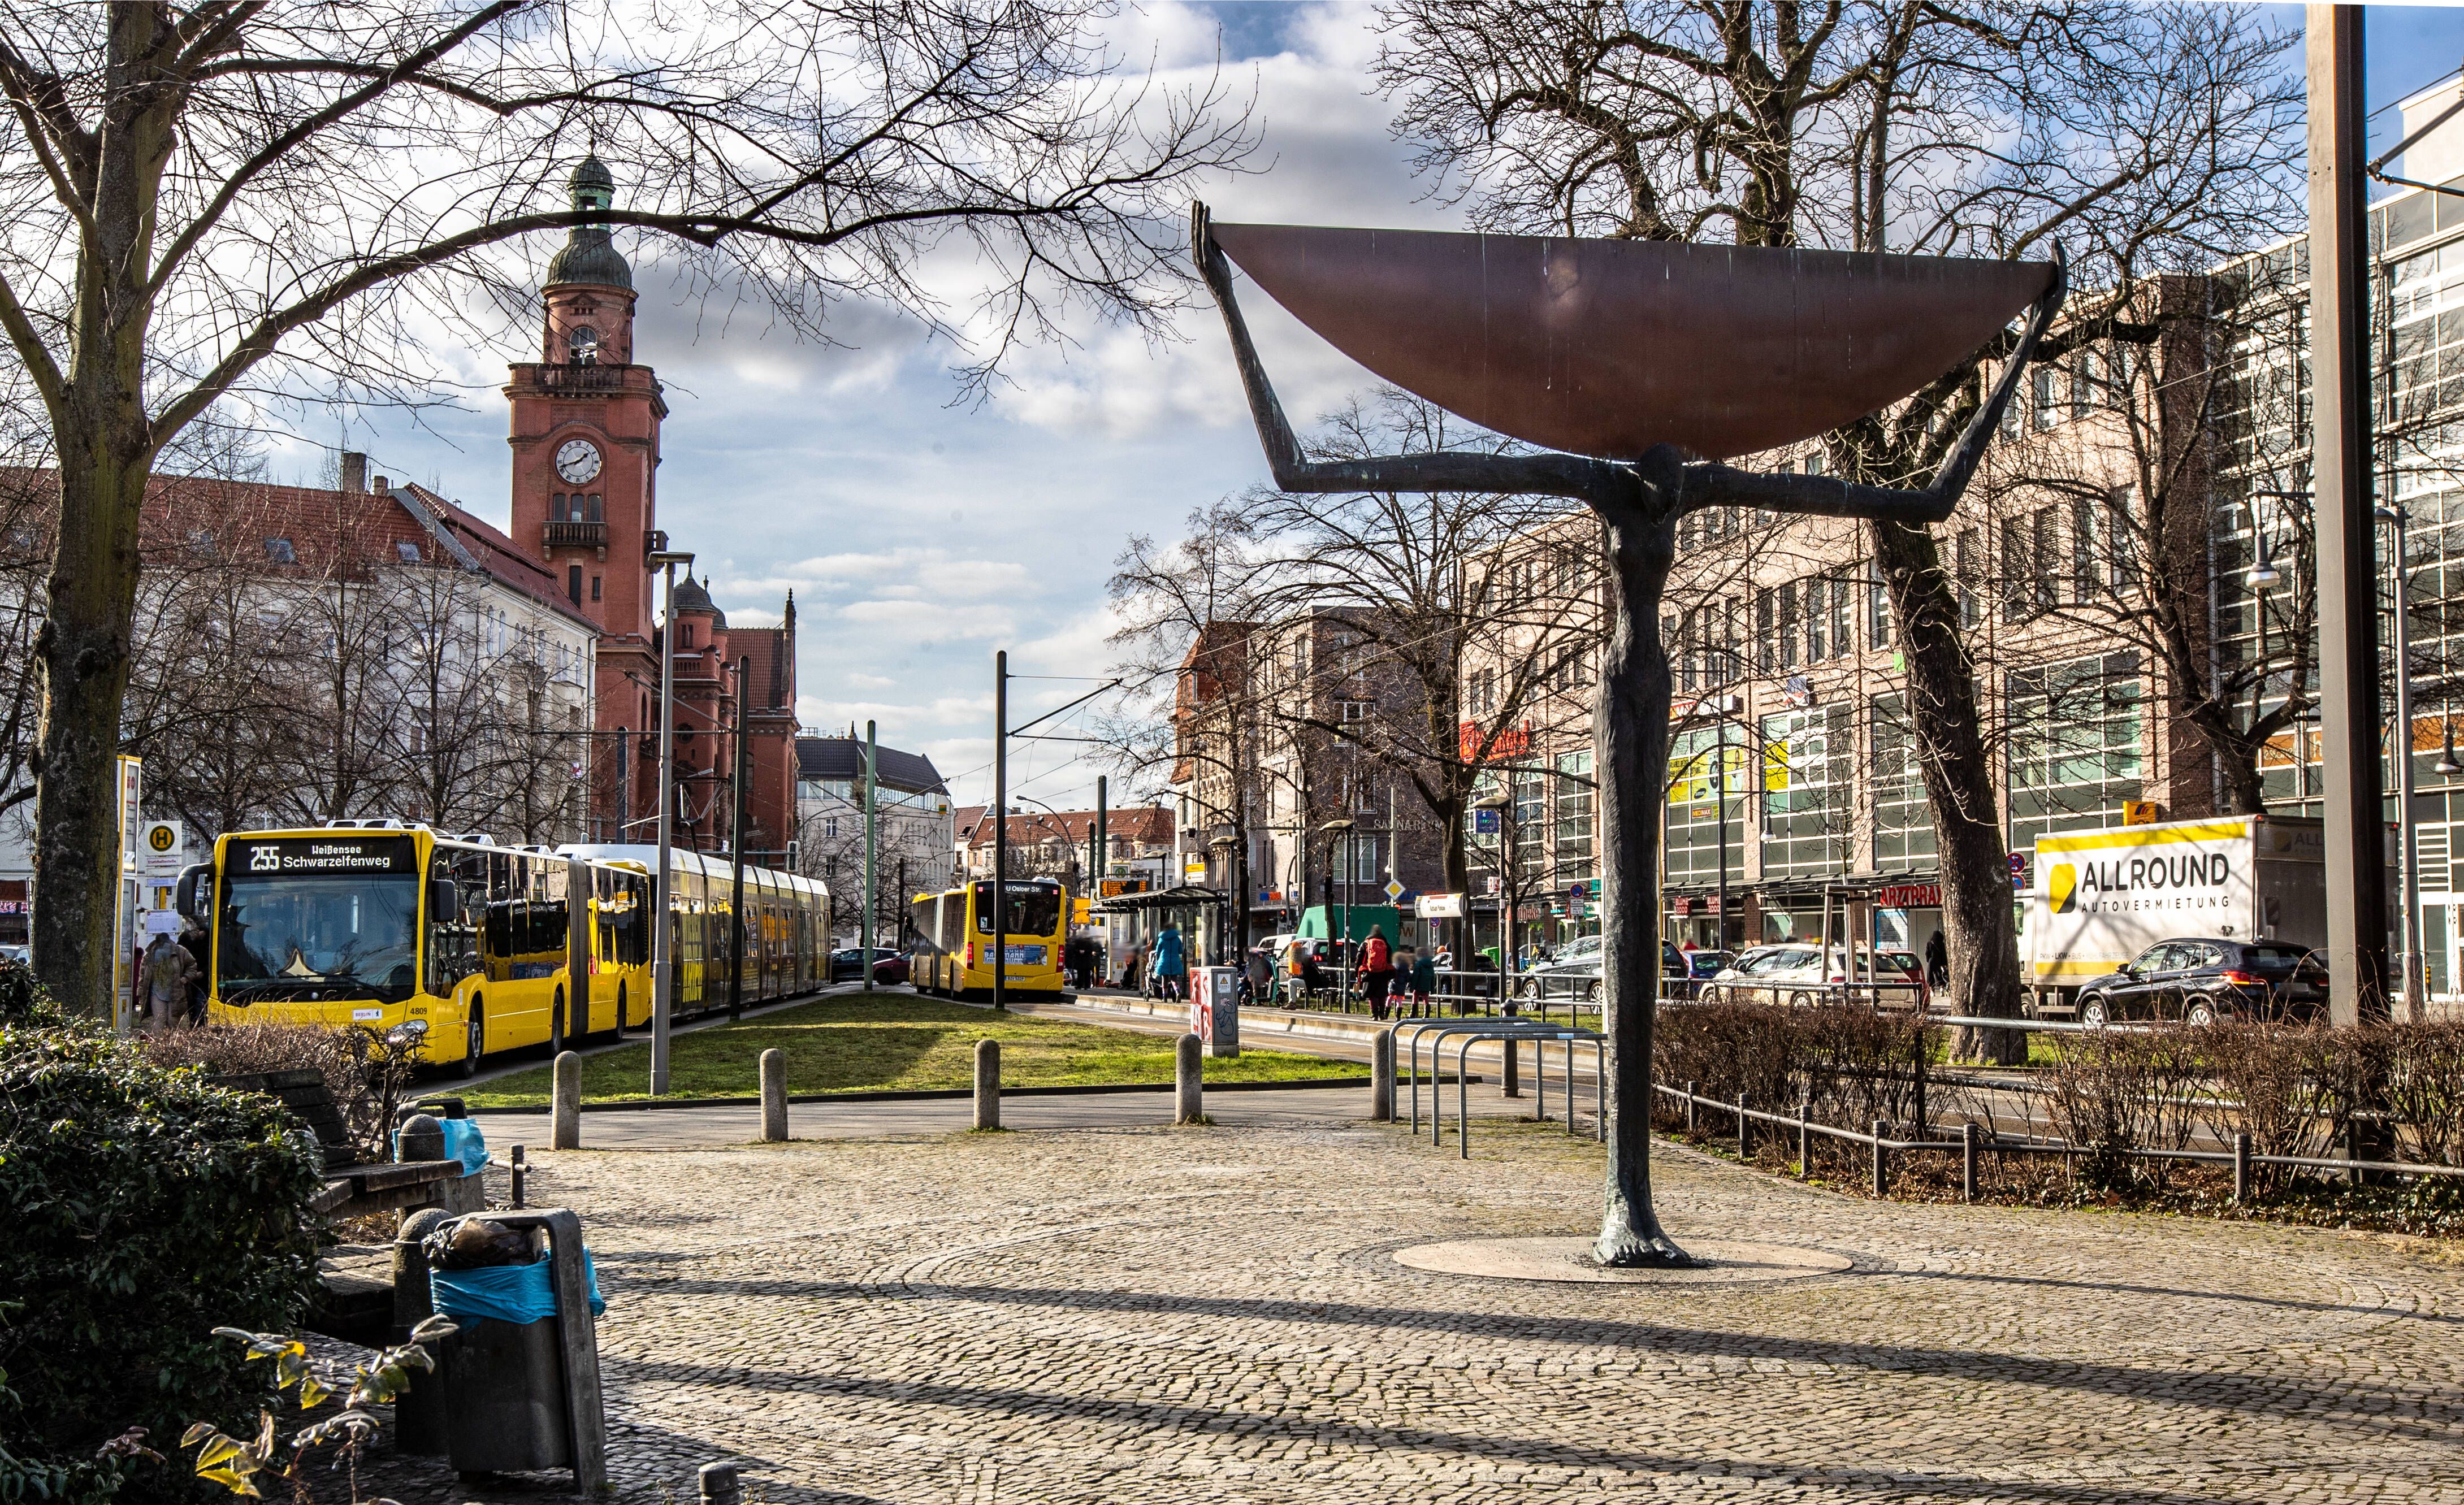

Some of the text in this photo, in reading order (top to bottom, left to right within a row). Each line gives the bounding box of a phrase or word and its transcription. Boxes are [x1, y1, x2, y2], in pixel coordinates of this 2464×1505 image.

[1692, 809, 1711, 817] MEDIMAX
[156, 831, 168, 845] H
[250, 845, 361, 870] 255 Weißensee
[283, 856, 390, 868] Schwarzelfenweg
[2082, 853, 2229, 893] ALLROUND
[1707, 896, 1720, 905] BLUM
[2081, 896, 2229, 913] AUTOVERMIETUNG
